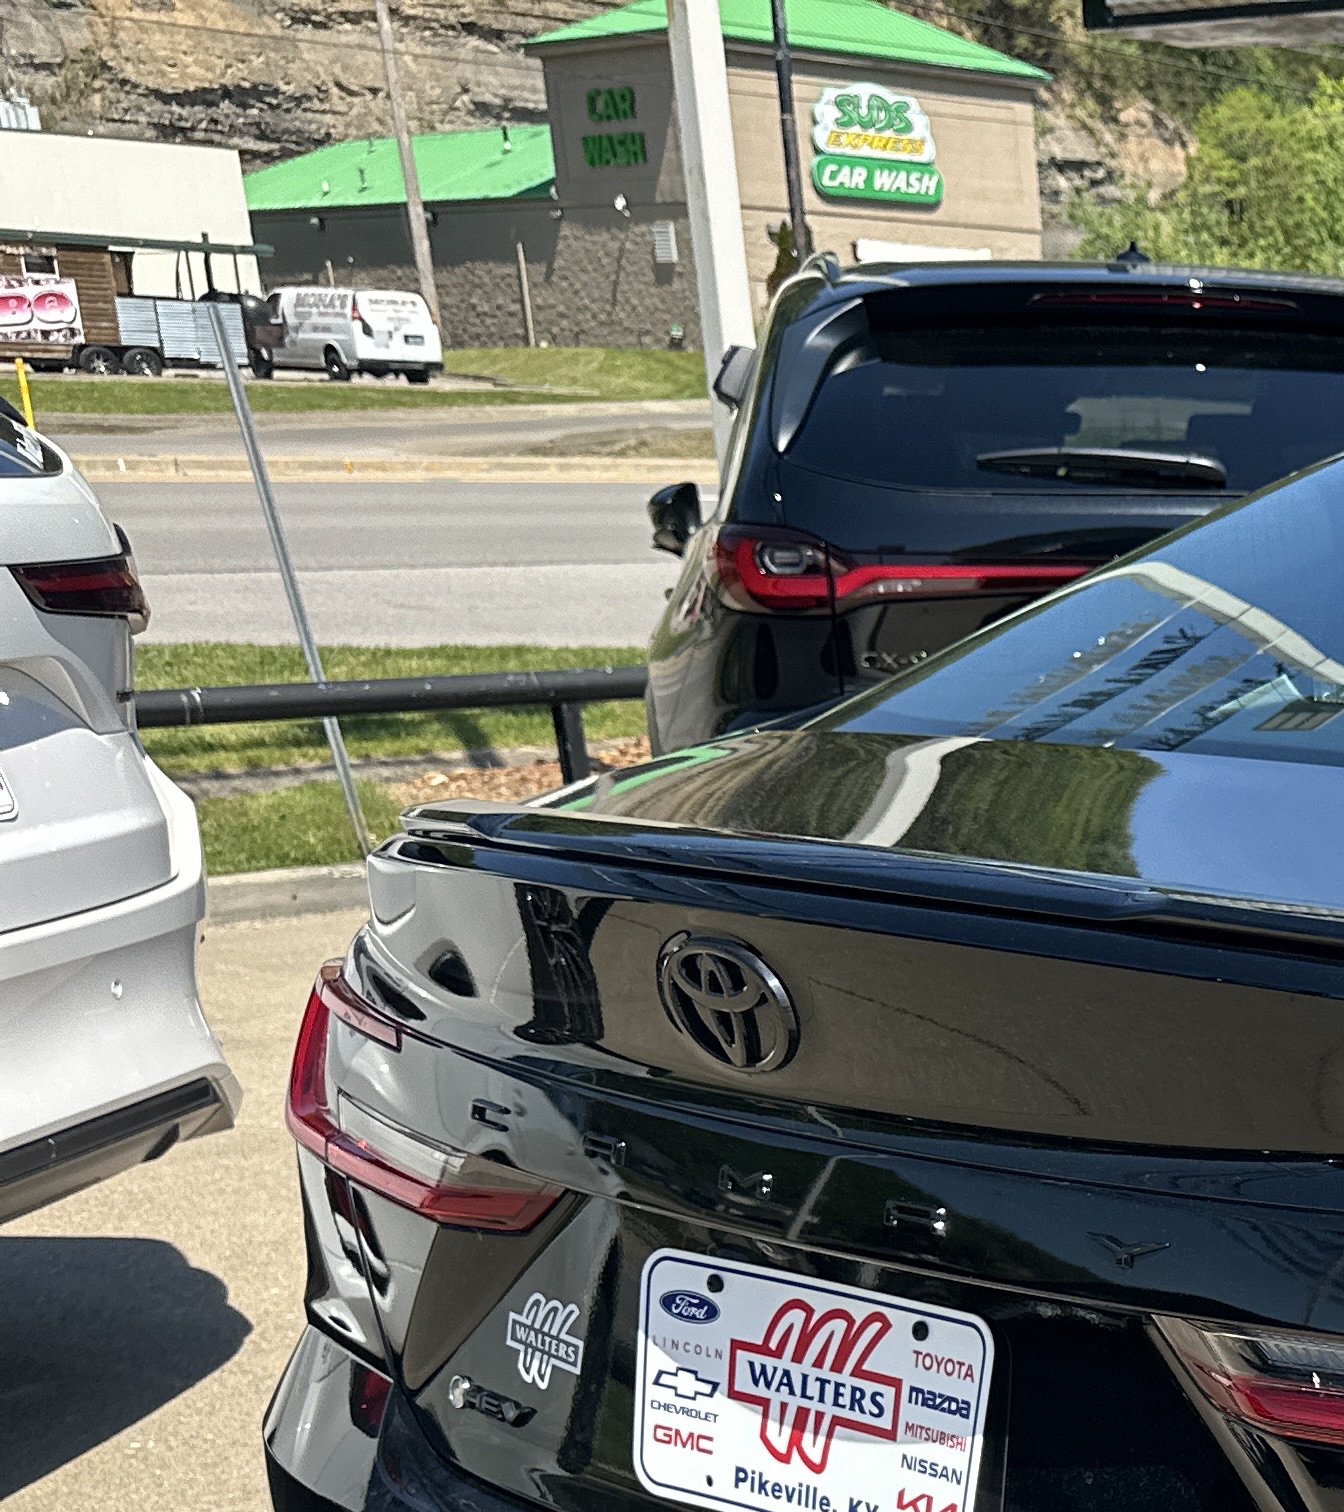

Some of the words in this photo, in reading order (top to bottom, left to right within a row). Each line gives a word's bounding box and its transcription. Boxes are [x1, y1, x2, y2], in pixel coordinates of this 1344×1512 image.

[586, 86, 637, 122] CAR
[834, 94, 914, 133] SUDS
[582, 132, 647, 167] WASH
[827, 131, 924, 155] EXPRESS
[821, 164, 868, 189] CAR
[873, 169, 940, 196] WASH
[672, 1294, 709, 1321] Ford
[515, 1322, 577, 1363] WALTERS
[651, 1335, 724, 1361] LINCOLN
[912, 1349, 975, 1384] TOYOTA
[747, 1359, 886, 1419] WALTERS
[650, 1399, 720, 1424] CHEVROLET
[653, 1424, 714, 1456] GMC
[904, 1421, 967, 1453] MITSUBISHI
[900, 1452, 963, 1486] NISSAN
